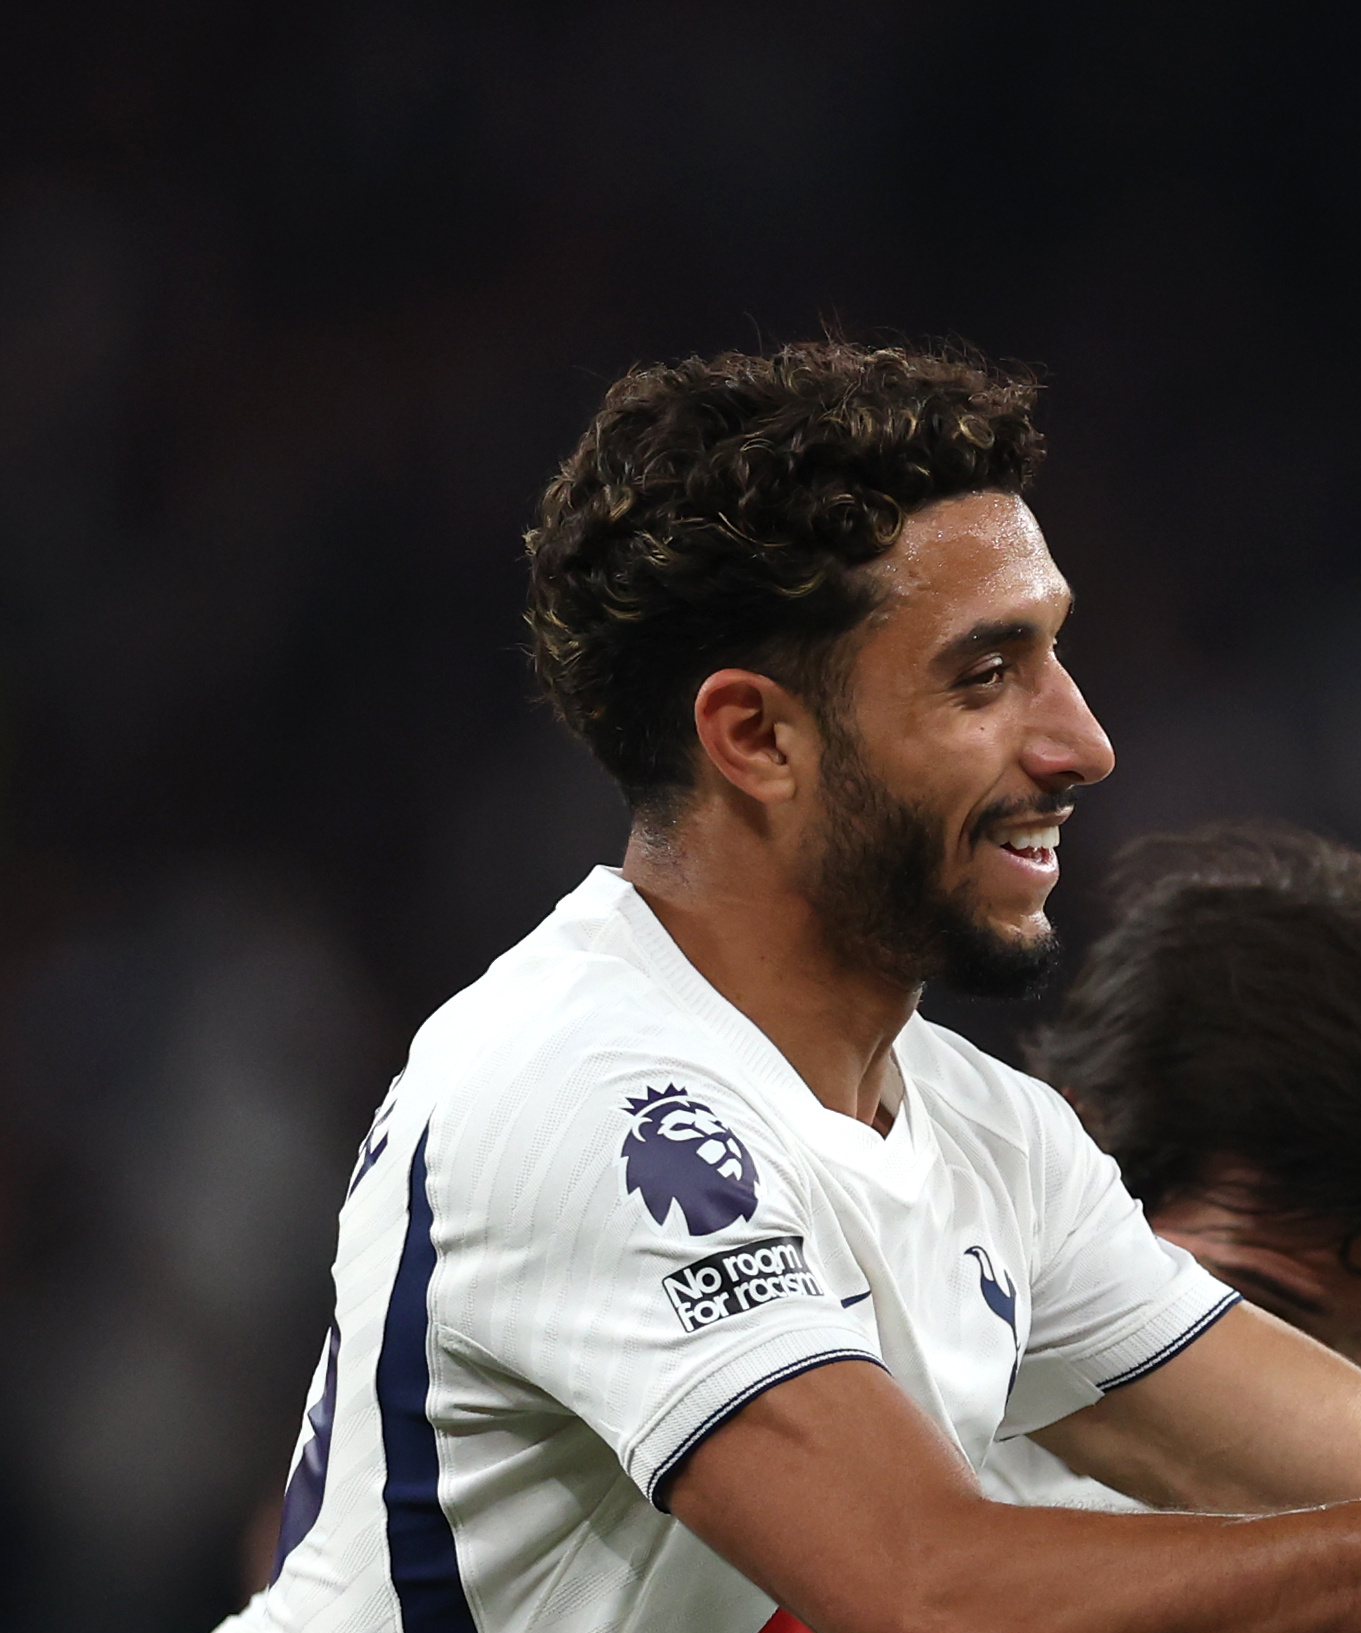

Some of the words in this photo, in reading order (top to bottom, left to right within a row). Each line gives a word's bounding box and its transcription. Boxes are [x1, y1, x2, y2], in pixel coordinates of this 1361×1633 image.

[663, 1266, 723, 1309] No
[722, 1244, 803, 1283] room
[677, 1293, 730, 1333] for
[734, 1271, 824, 1311] racism
